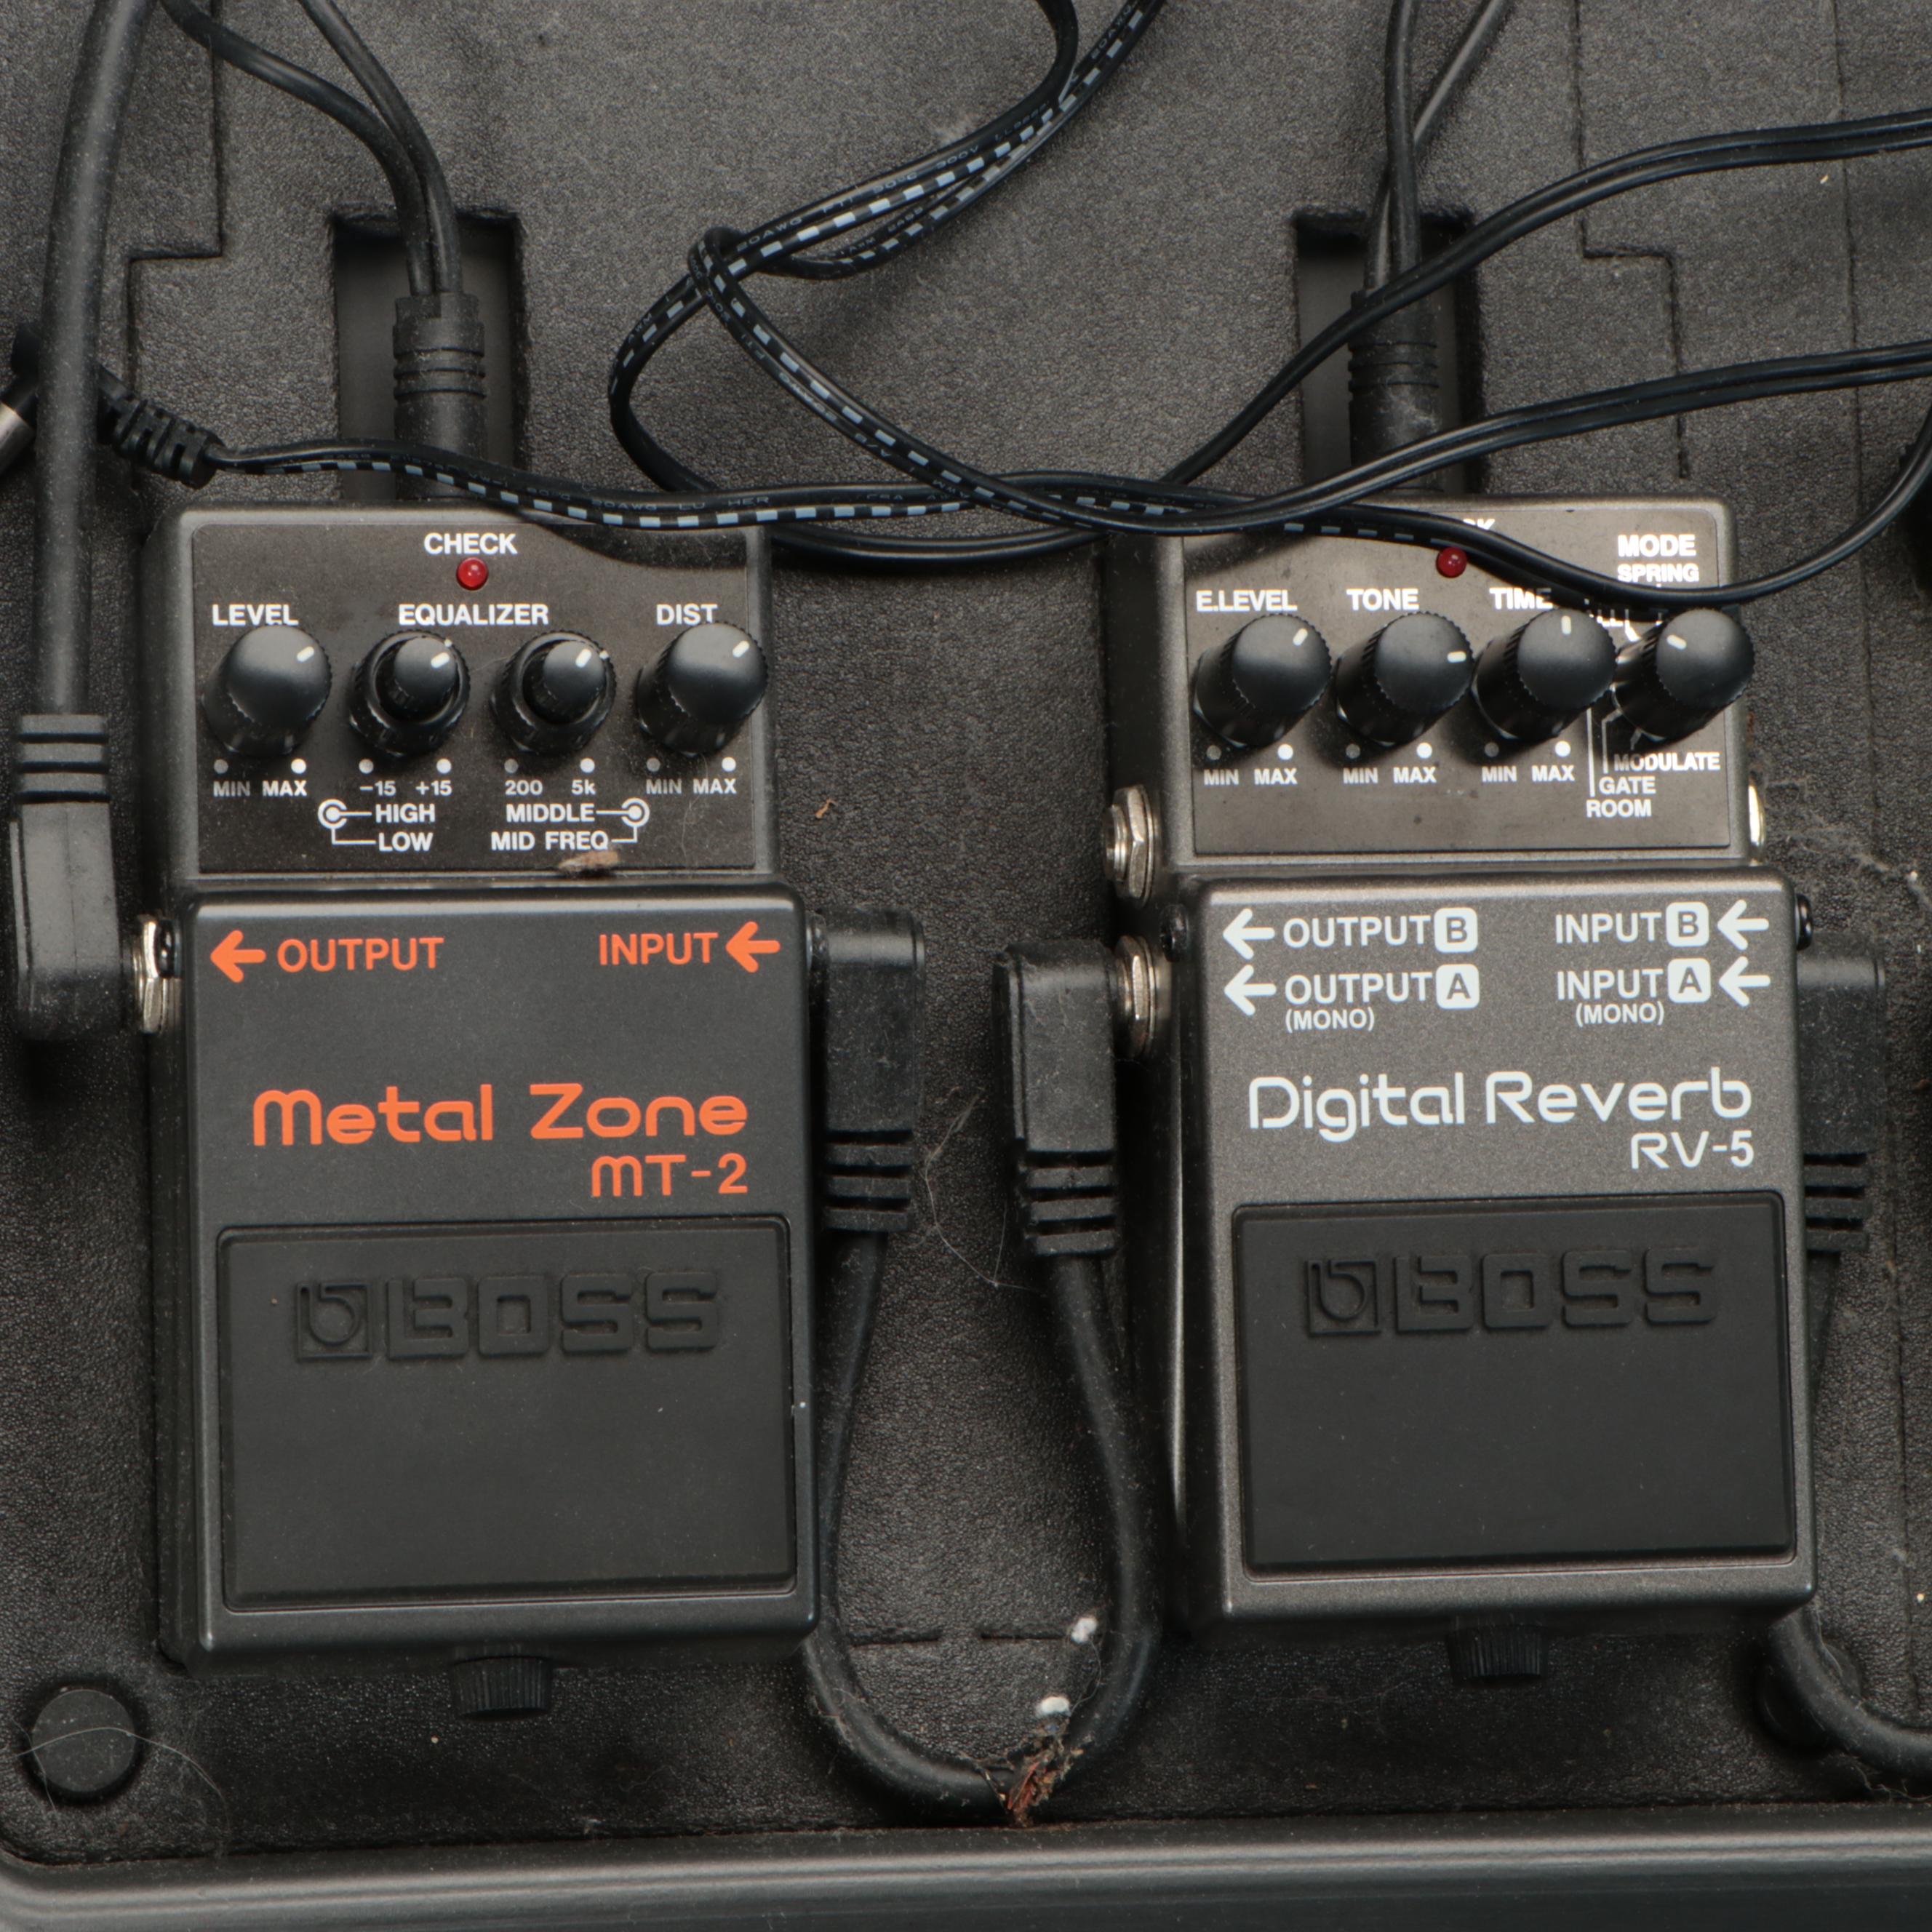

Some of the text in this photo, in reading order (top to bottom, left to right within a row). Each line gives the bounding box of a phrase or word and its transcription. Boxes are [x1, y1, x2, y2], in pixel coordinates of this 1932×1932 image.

[424, 532, 517, 554] CHECK
[1618, 534, 1696, 557] MODE
[1618, 563, 1699, 583] SPRING
[1197, 589, 1298, 612] E.LEVEL
[1346, 588, 1419, 611] TONE
[1488, 586, 1553, 610] TIME
[212, 604, 298, 626] LEVEL
[399, 604, 548, 626] EQUALIZER
[657, 603, 717, 626] DIST
[1615, 751, 1720, 772] MODULATE
[1203, 768, 1297, 786] MIN MAX
[1344, 767, 1436, 784] MIN MAX
[1482, 765, 1575, 782] MIN MAX
[1600, 775, 1656, 795] GATE
[213, 780, 307, 797] MIN MAX
[360, 780, 452, 797] -15 +15
[506, 779, 596, 796] 200 5k
[646, 778, 736, 794] MIN MAX
[376, 803, 435, 823] HIGH
[506, 803, 594, 822] MIDDLE
[1586, 799, 1651, 818] ROOM
[379, 831, 433, 852] LOW
[492, 830, 610, 852] MID FREQ
[1284, 915, 1431, 948] OUTPUT
[1556, 911, 1661, 943] INPUT
[278, 937, 444, 972] OUTPUT
[600, 933, 718, 965] INPUT
[1285, 972, 1432, 1005] OUTPUT
[1557, 968, 1663, 1000] INPUT
[1286, 1007, 1374, 1033] (MONO)
[1576, 1001, 1664, 1027] (MONO)
[253, 1083, 747, 1146] Metal Zone
[1249, 1066, 1751, 1143] Digital Reverb
[1631, 1130, 1754, 1169] RV-5
[592, 1153, 748, 1197] MT-2
[1394, 1248, 1717, 1334] BOSS
[387, 1272, 719, 1361] BOSS
